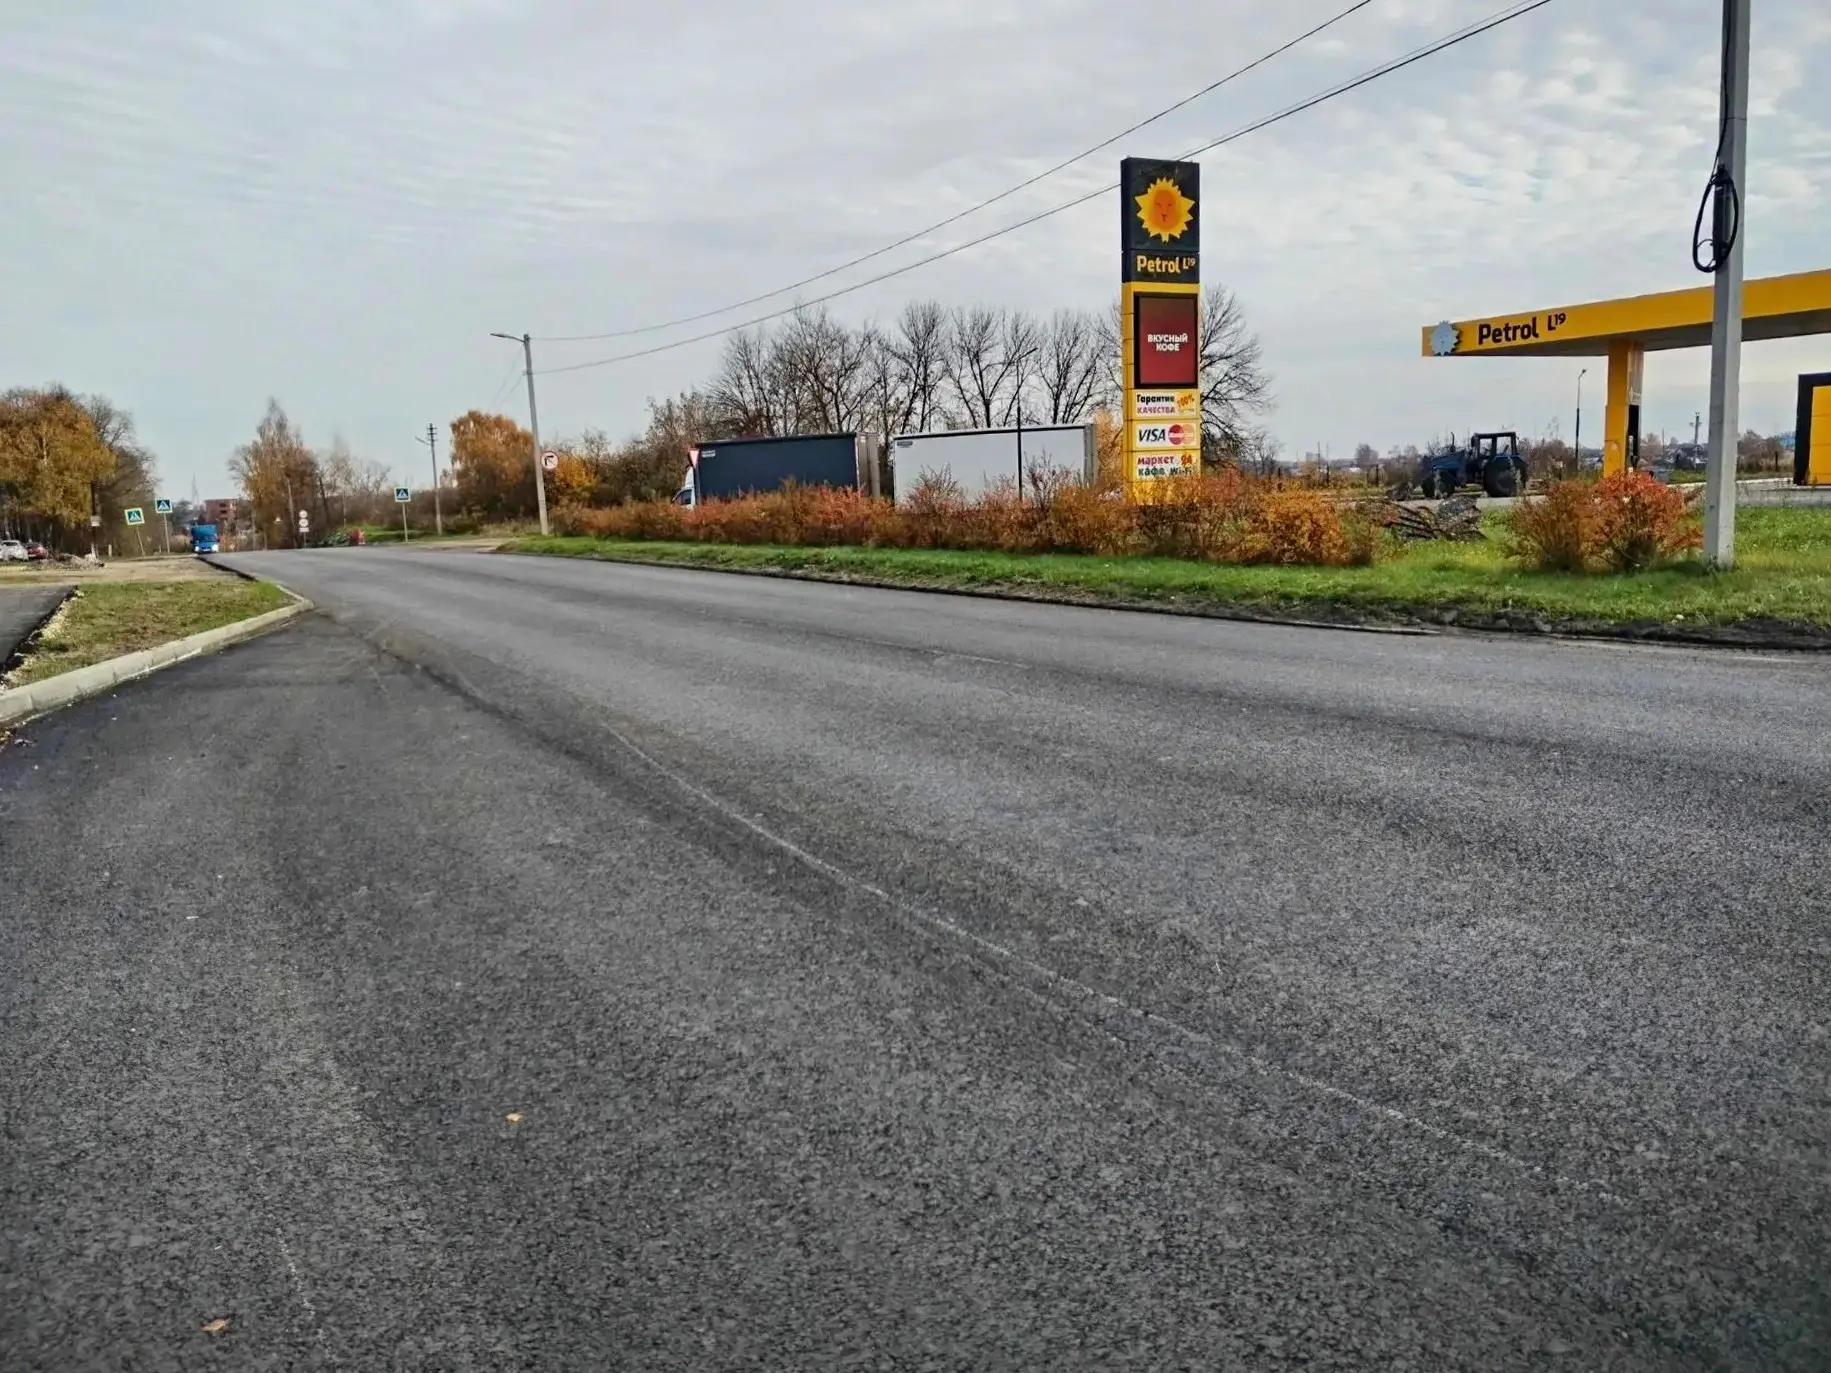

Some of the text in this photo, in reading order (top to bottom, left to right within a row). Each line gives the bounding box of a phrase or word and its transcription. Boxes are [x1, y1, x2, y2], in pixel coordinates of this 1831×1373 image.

[1136, 255, 1181, 274] Petrol
[1478, 316, 1539, 345] Petrol
[1147, 333, 1188, 343] ВКУСНЫЙ
[1156, 343, 1180, 351] КОФЕ
[1138, 428, 1166, 442] VISA
[1137, 455, 1175, 466] маркет
[1138, 466, 1165, 477] кафе
